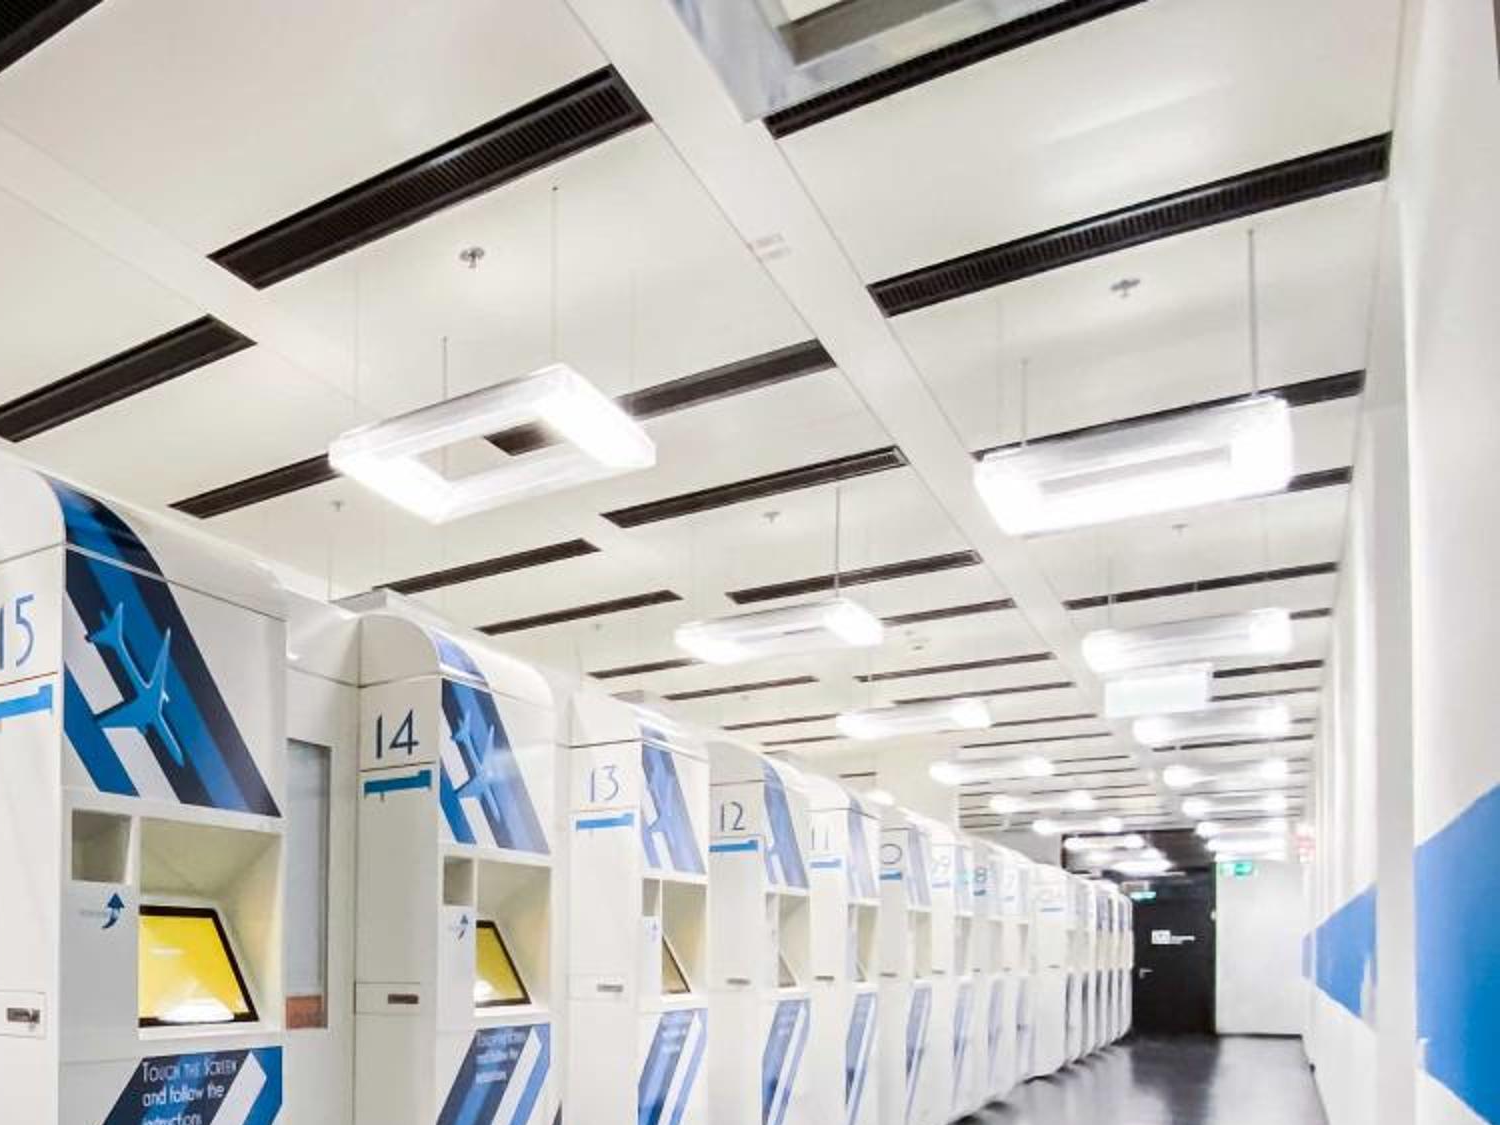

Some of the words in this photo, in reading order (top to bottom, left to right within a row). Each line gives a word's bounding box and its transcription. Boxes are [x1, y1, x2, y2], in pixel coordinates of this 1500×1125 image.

[375, 709, 420, 759] 14
[590, 764, 619, 803] 13
[720, 801, 744, 832] 12
[880, 843, 902, 865] 0
[142, 1085, 167, 1107] and
[207, 1081, 225, 1099] the
